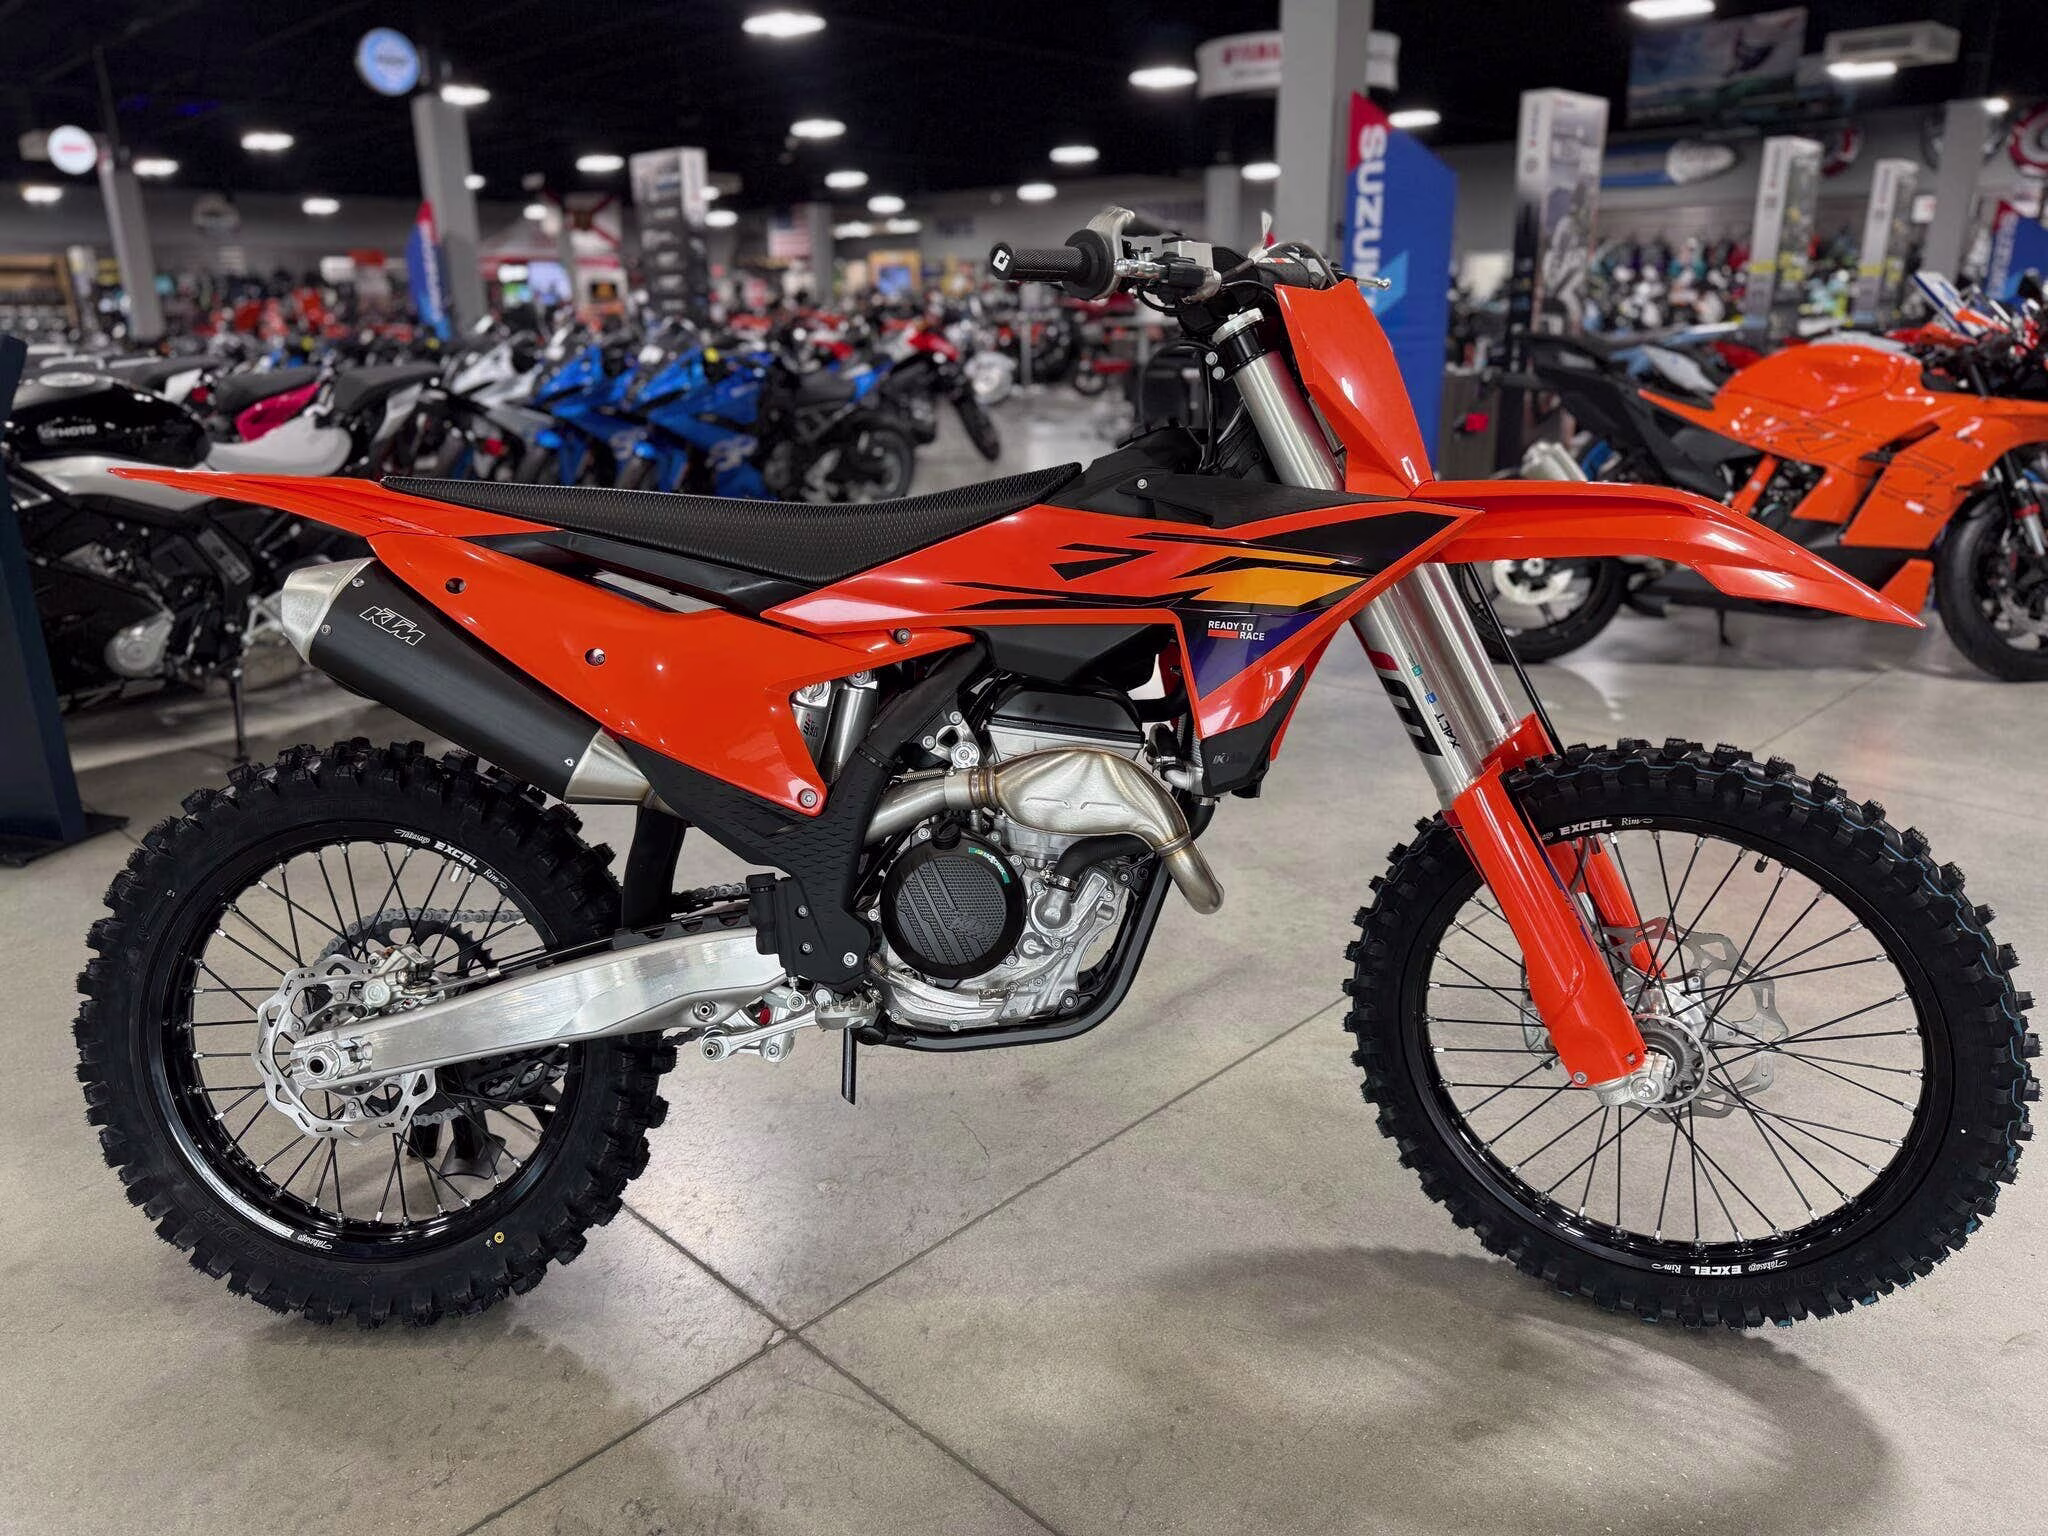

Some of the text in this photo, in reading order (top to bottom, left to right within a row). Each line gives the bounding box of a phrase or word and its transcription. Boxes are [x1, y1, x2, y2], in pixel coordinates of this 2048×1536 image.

[1353, 124, 1388, 304] SUZUK
[359, 605, 426, 646] KTM
[1208, 620, 1254, 632] READY TO
[1239, 631, 1265, 641] RACE
[1434, 713, 1461, 749] XACT
[1559, 819, 1613, 836] EXCEL
[1621, 817, 1653, 826] Rim
[433, 840, 478, 869] EXCEL
[483, 868, 508, 889] Rim
[1651, 1259, 1788, 1276] Takasago EXCEL Rim
